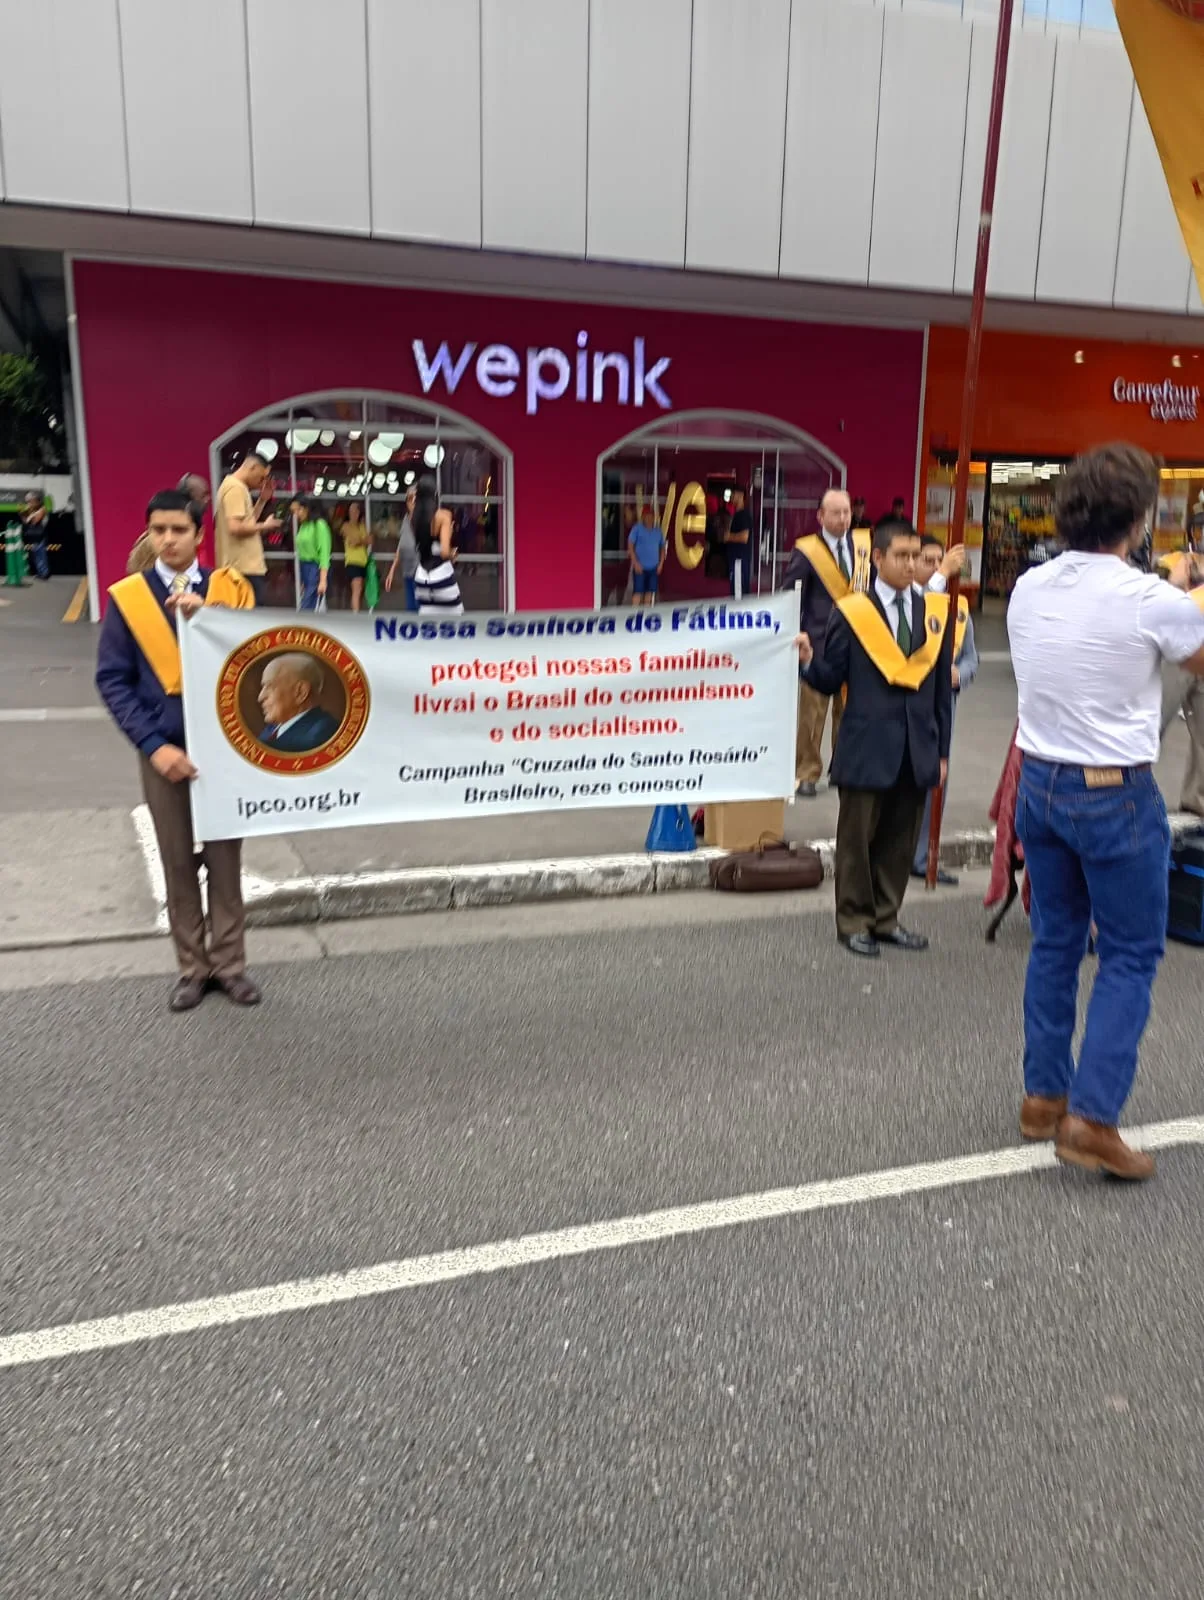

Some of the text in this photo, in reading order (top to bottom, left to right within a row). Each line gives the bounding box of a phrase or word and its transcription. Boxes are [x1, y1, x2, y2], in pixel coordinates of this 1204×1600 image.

[411, 329, 672, 415] wepink
[374, 603, 781, 641] Nossa Senhora de Fátima,
[431, 648, 740, 686] protegei nossas famílias,
[414, 681, 754, 715] livrai o Brasil do comunismo
[489, 715, 684, 743] e do socialismo.
[399, 760, 505, 783] Campanha
[602, 753, 625, 769] do
[630, 750, 684, 768] Santo
[237, 789, 361, 818] ipco.org.br
[464, 774, 703, 804] Brasileiro, reze conosco!
